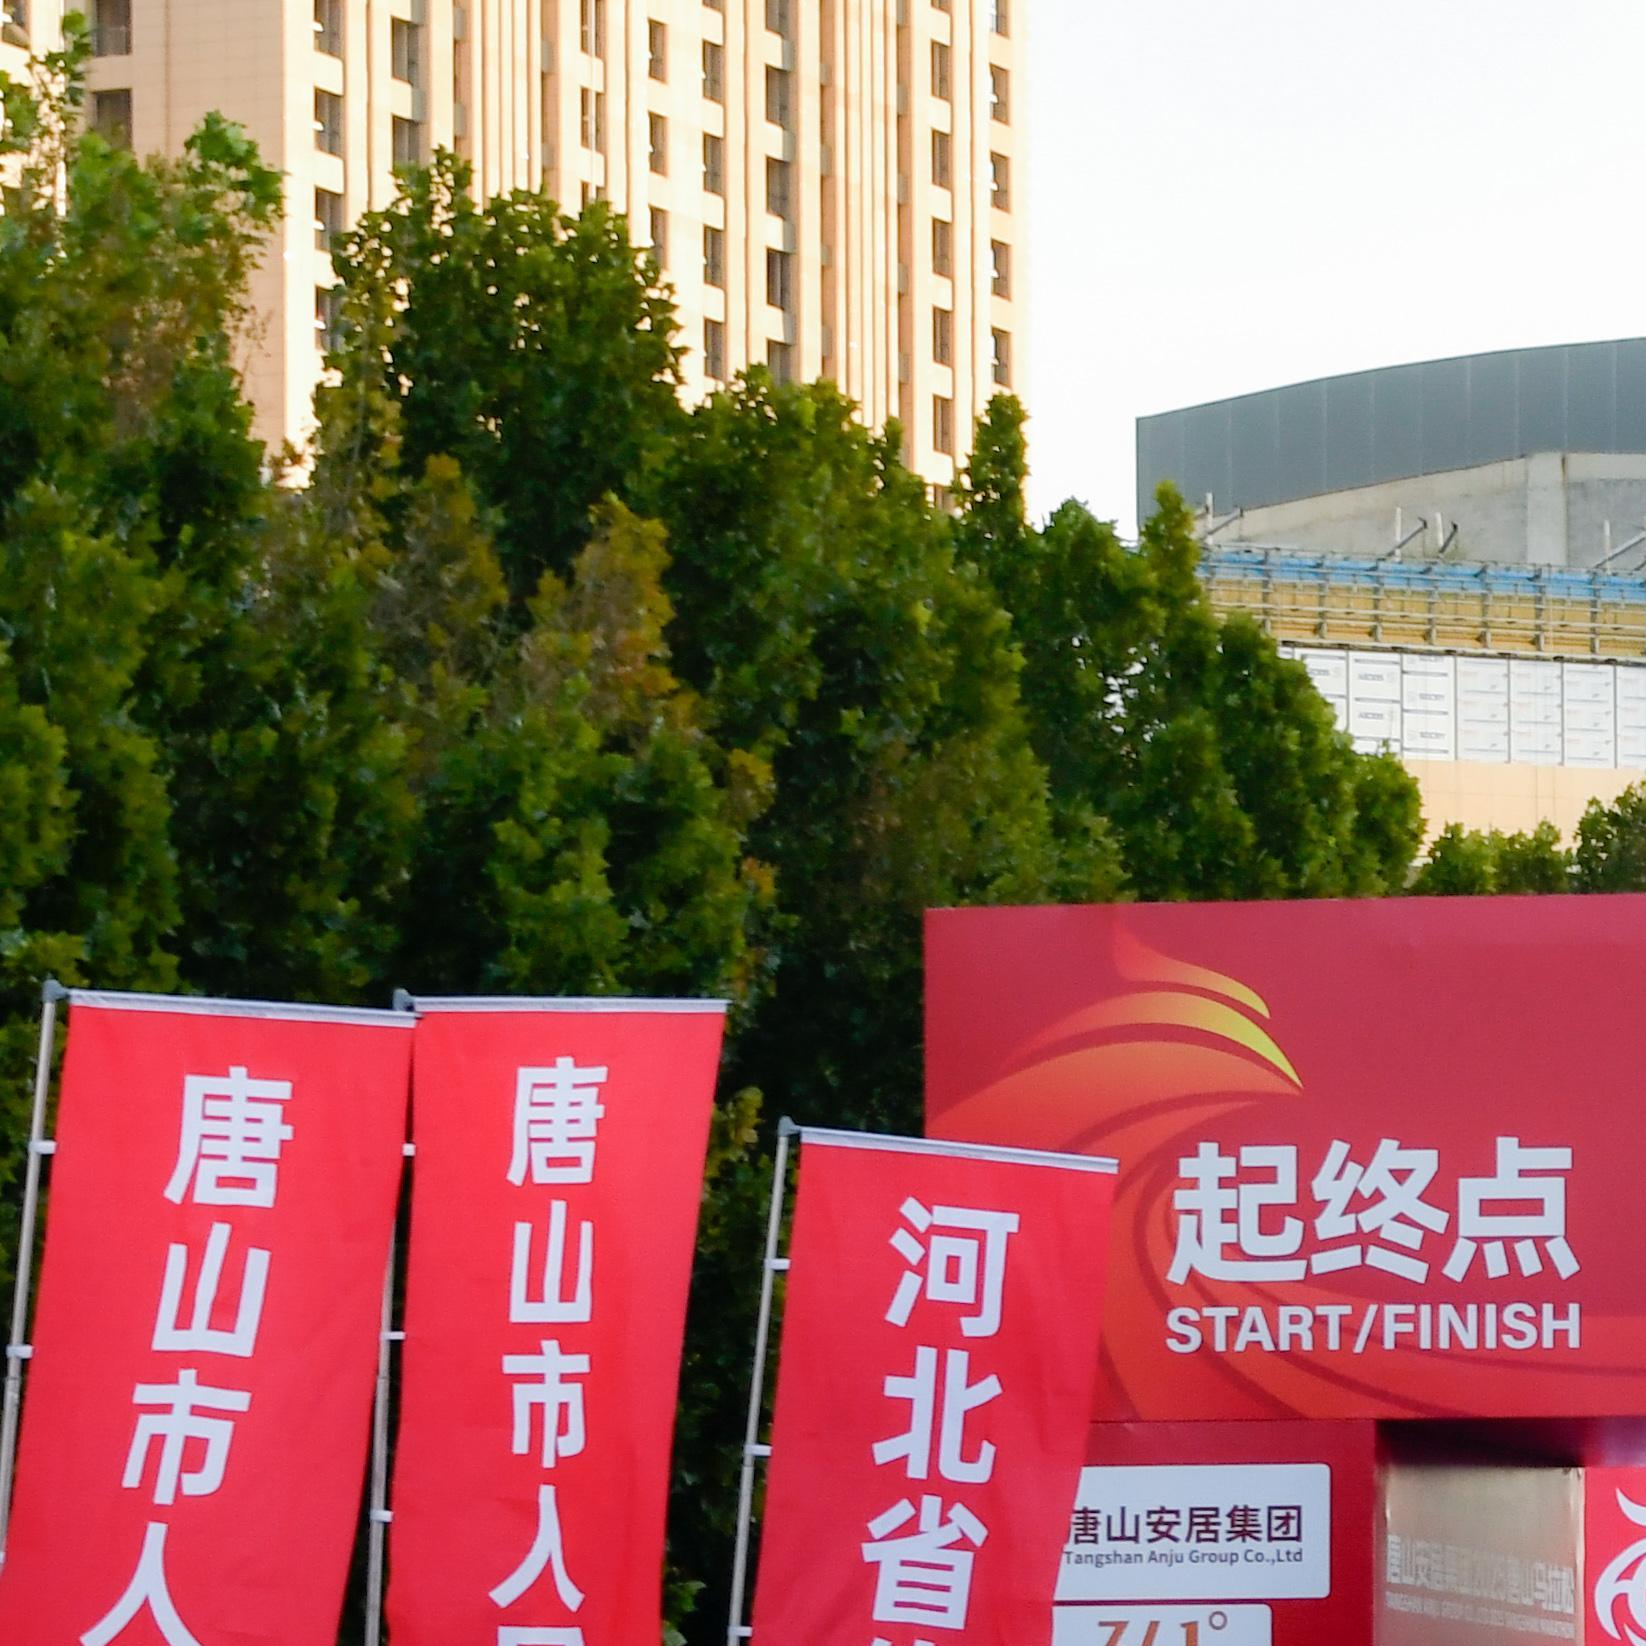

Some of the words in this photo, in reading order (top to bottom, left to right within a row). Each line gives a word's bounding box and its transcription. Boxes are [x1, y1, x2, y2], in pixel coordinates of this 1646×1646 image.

[1166, 1136, 1581, 1284] 起终点
[1165, 1301, 1581, 1354] START/FINISH
[1071, 1504, 1303, 1545] 唐山安居集团
[1064, 1550, 1143, 1568] Tangshan
[1148, 1549, 1184, 1567] Anju
[1189, 1549, 1239, 1565] Group
[1244, 1548, 1303, 1564] Co.,Ltd
